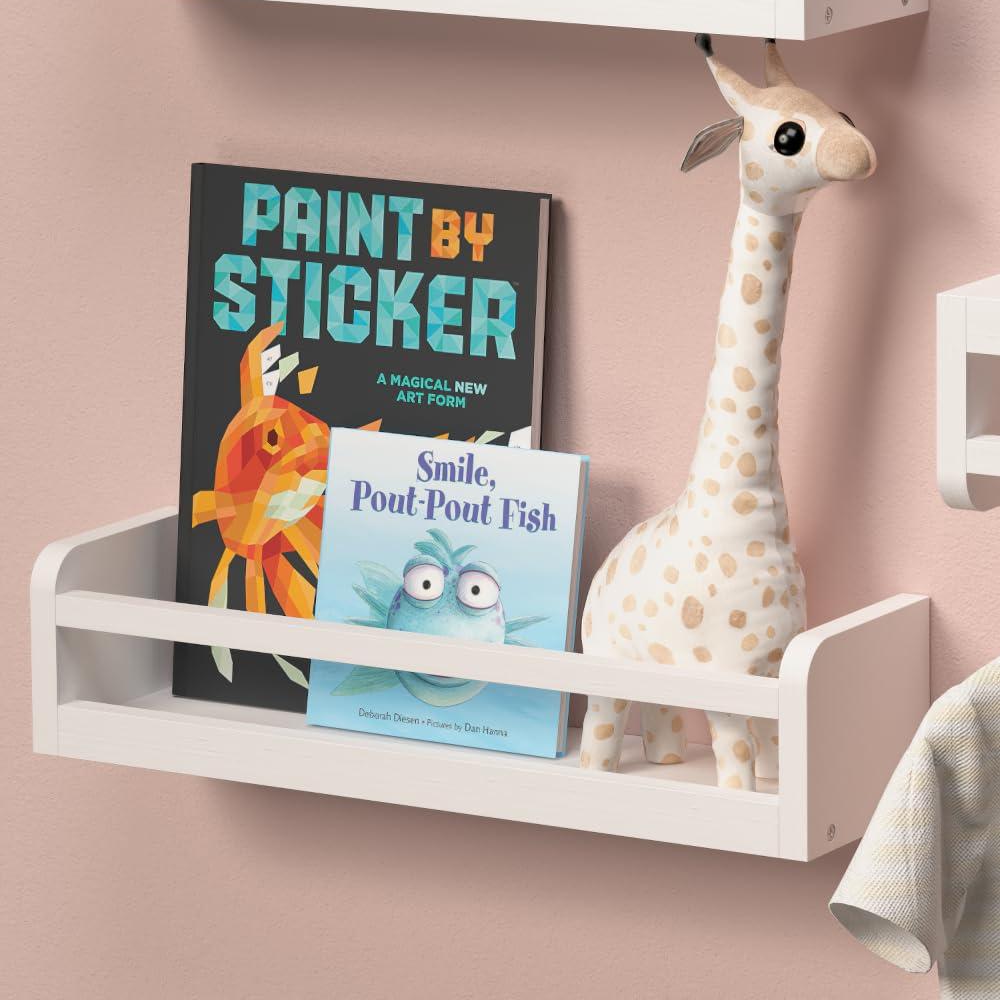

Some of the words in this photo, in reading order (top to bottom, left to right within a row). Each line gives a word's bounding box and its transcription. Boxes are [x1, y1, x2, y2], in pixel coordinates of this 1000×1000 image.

[241, 182, 424, 262] PAINT
[430, 207, 495, 263] BY
[212, 253, 517, 360] STICKER
[376, 371, 388, 386] A
[390, 373, 452, 393] MAGICAL
[454, 380, 488, 396] NEW
[396, 390, 424, 405] ART
[427, 392, 466, 409] FORM
[416, 450, 497, 492] Smile,
[350, 479, 492, 526] Pout-Pout
[498, 497, 557, 533] Fish
[358, 707, 392, 721] Deborah
[393, 712, 420, 725] Diesen
[454, 722, 465, 732] by
[464, 722, 481, 733] Dan
[482, 725, 508, 737] Hanna
